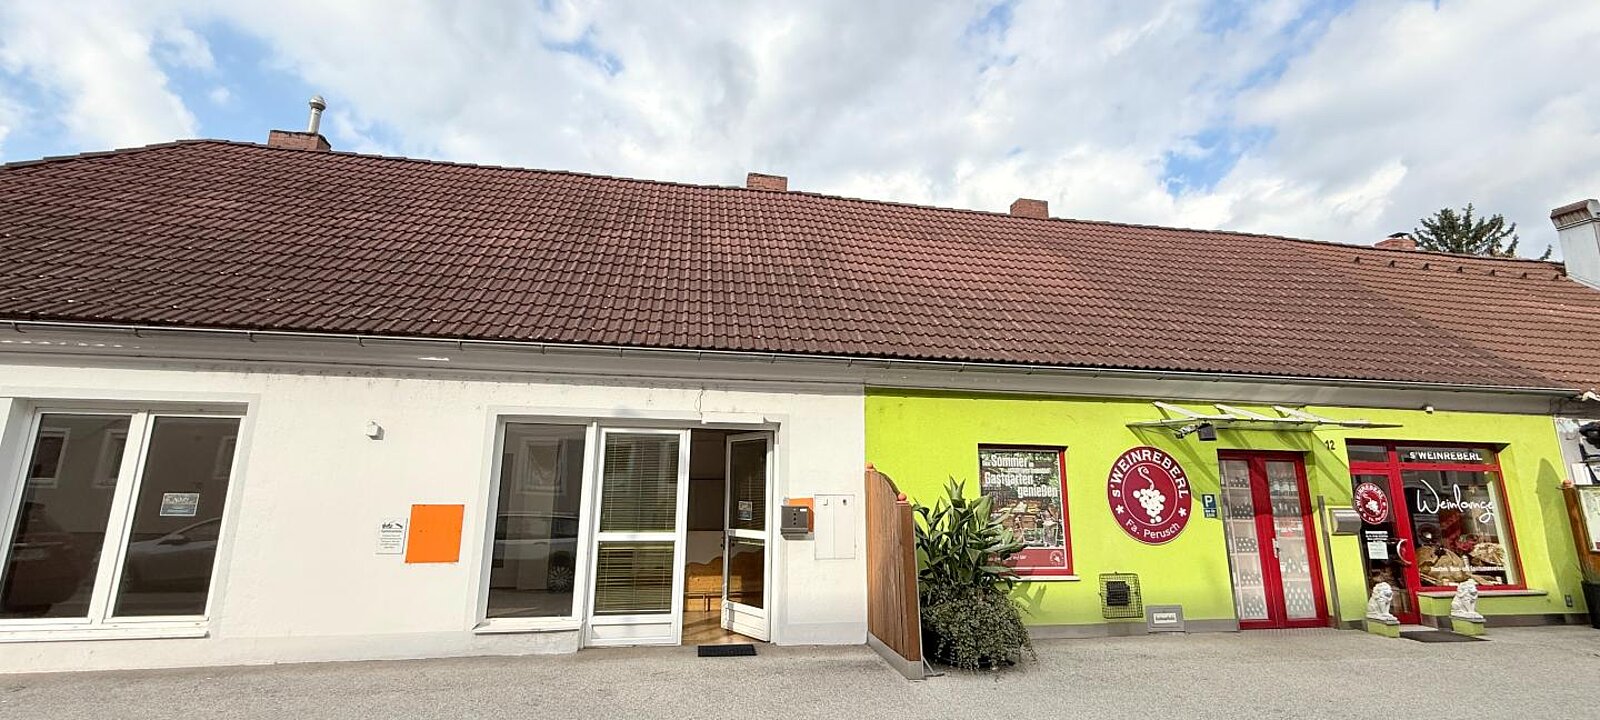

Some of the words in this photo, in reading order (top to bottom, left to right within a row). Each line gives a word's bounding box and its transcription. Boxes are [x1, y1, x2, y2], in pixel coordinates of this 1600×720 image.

[1325, 439, 1336, 450] 12
[991, 454, 1028, 467] Sommer
[984, 471, 1034, 487] Gastgarten
[1204, 495, 1213, 508] P
[1126, 519, 1140, 535] Fa.
[1143, 523, 1181, 539] Perusch
